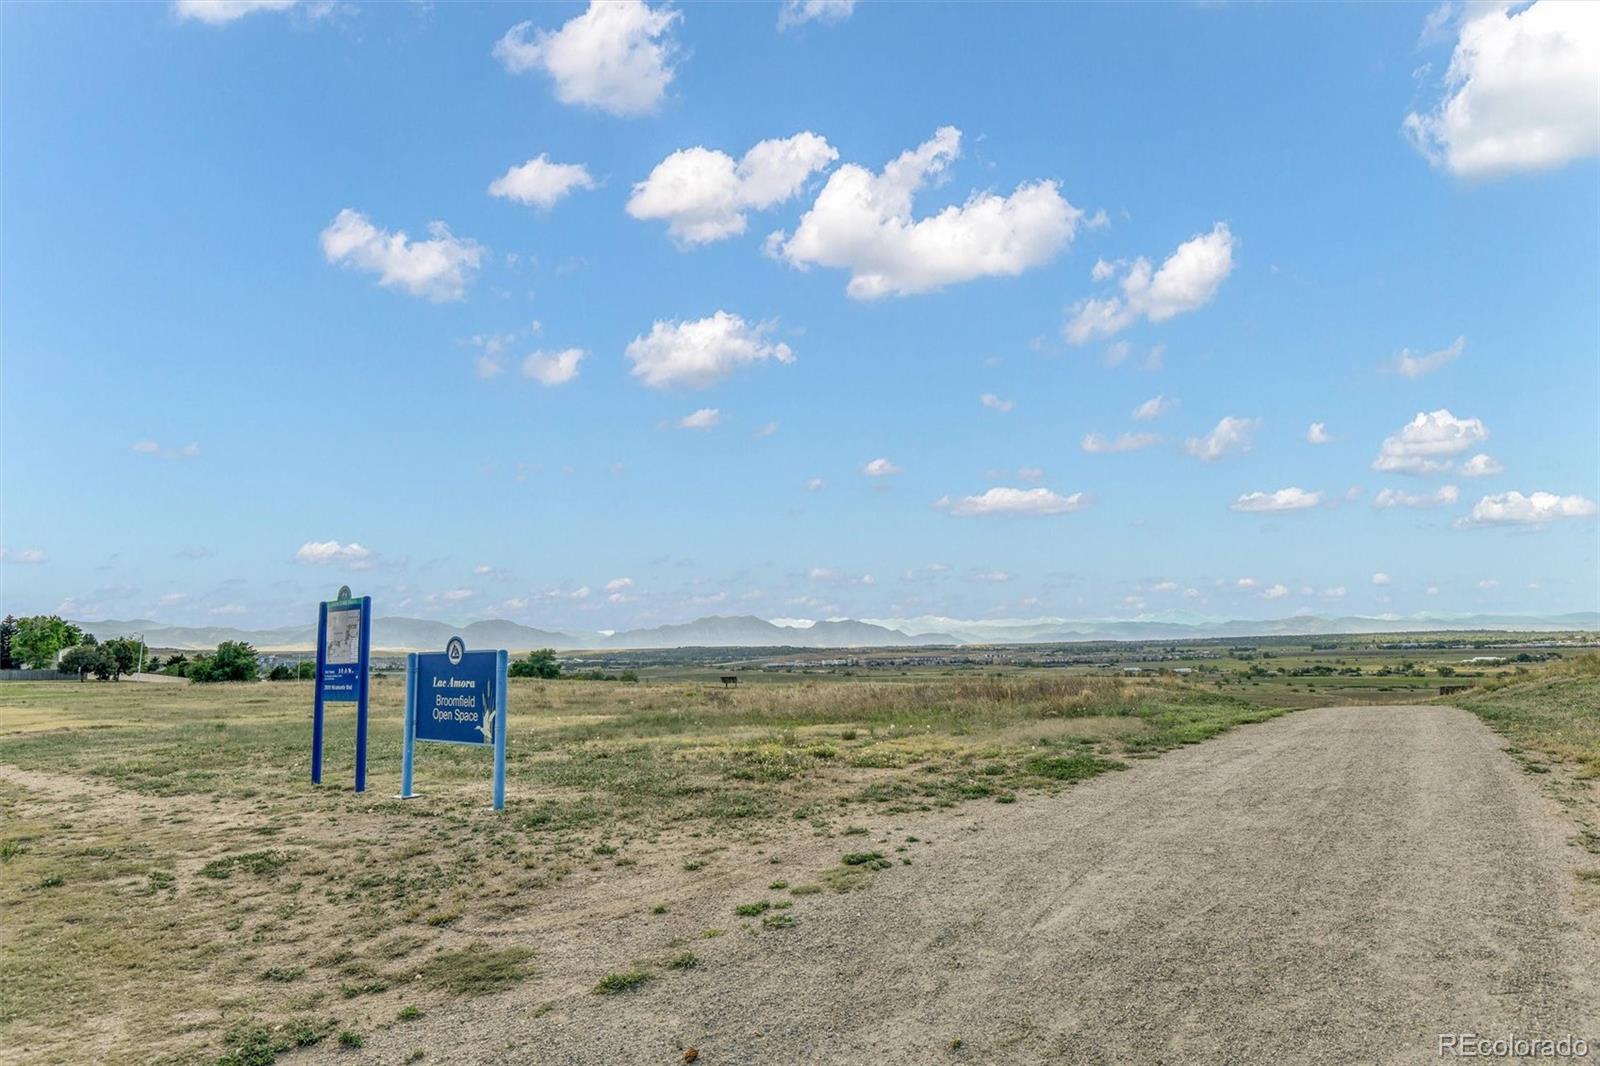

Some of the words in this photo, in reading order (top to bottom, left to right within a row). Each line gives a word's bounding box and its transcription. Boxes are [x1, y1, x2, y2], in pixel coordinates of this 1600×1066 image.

[433, 676, 447, 688] Lac
[447, 676, 476, 688] Amora
[436, 694, 476, 708] Broomfield
[433, 707, 453, 723] Open
[454, 708, 479, 724] Space
